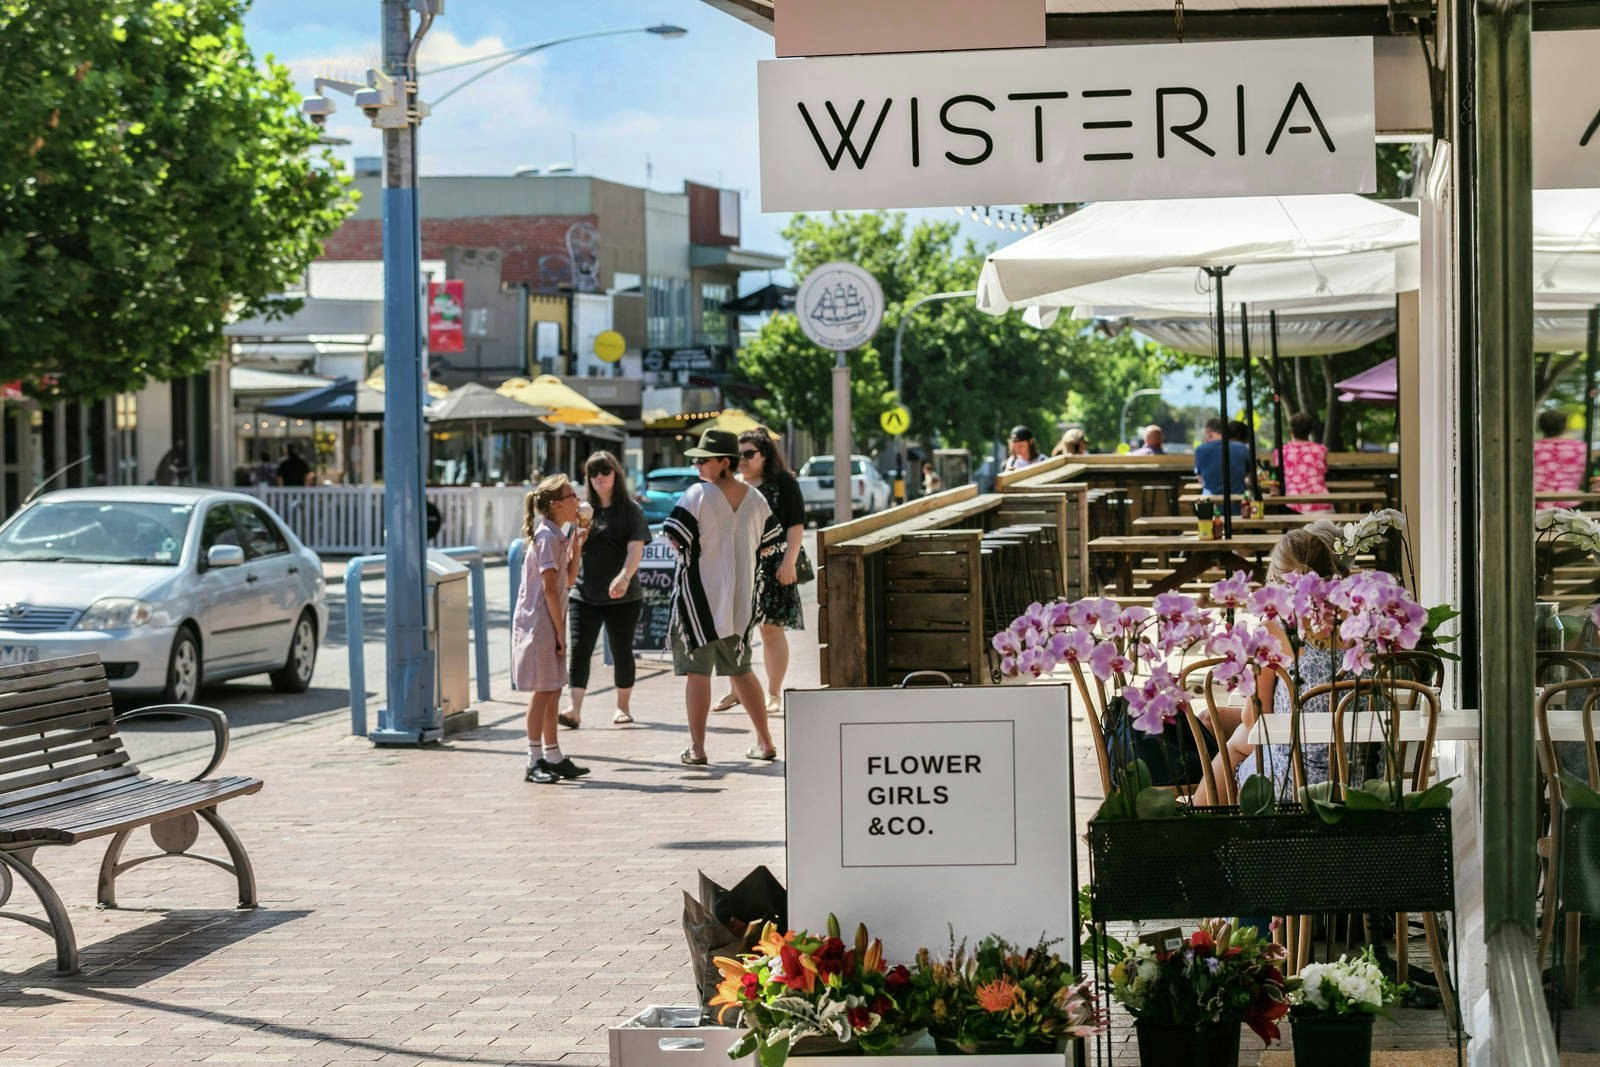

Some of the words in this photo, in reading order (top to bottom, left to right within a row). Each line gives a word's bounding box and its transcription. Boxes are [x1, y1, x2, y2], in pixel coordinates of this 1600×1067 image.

[797, 81, 1336, 172] WISTERIA
[641, 546, 675, 559] UBLIC
[867, 755, 982, 775] FLOWER
[867, 786, 949, 805] GIRLS
[868, 816, 934, 836] &CO.
